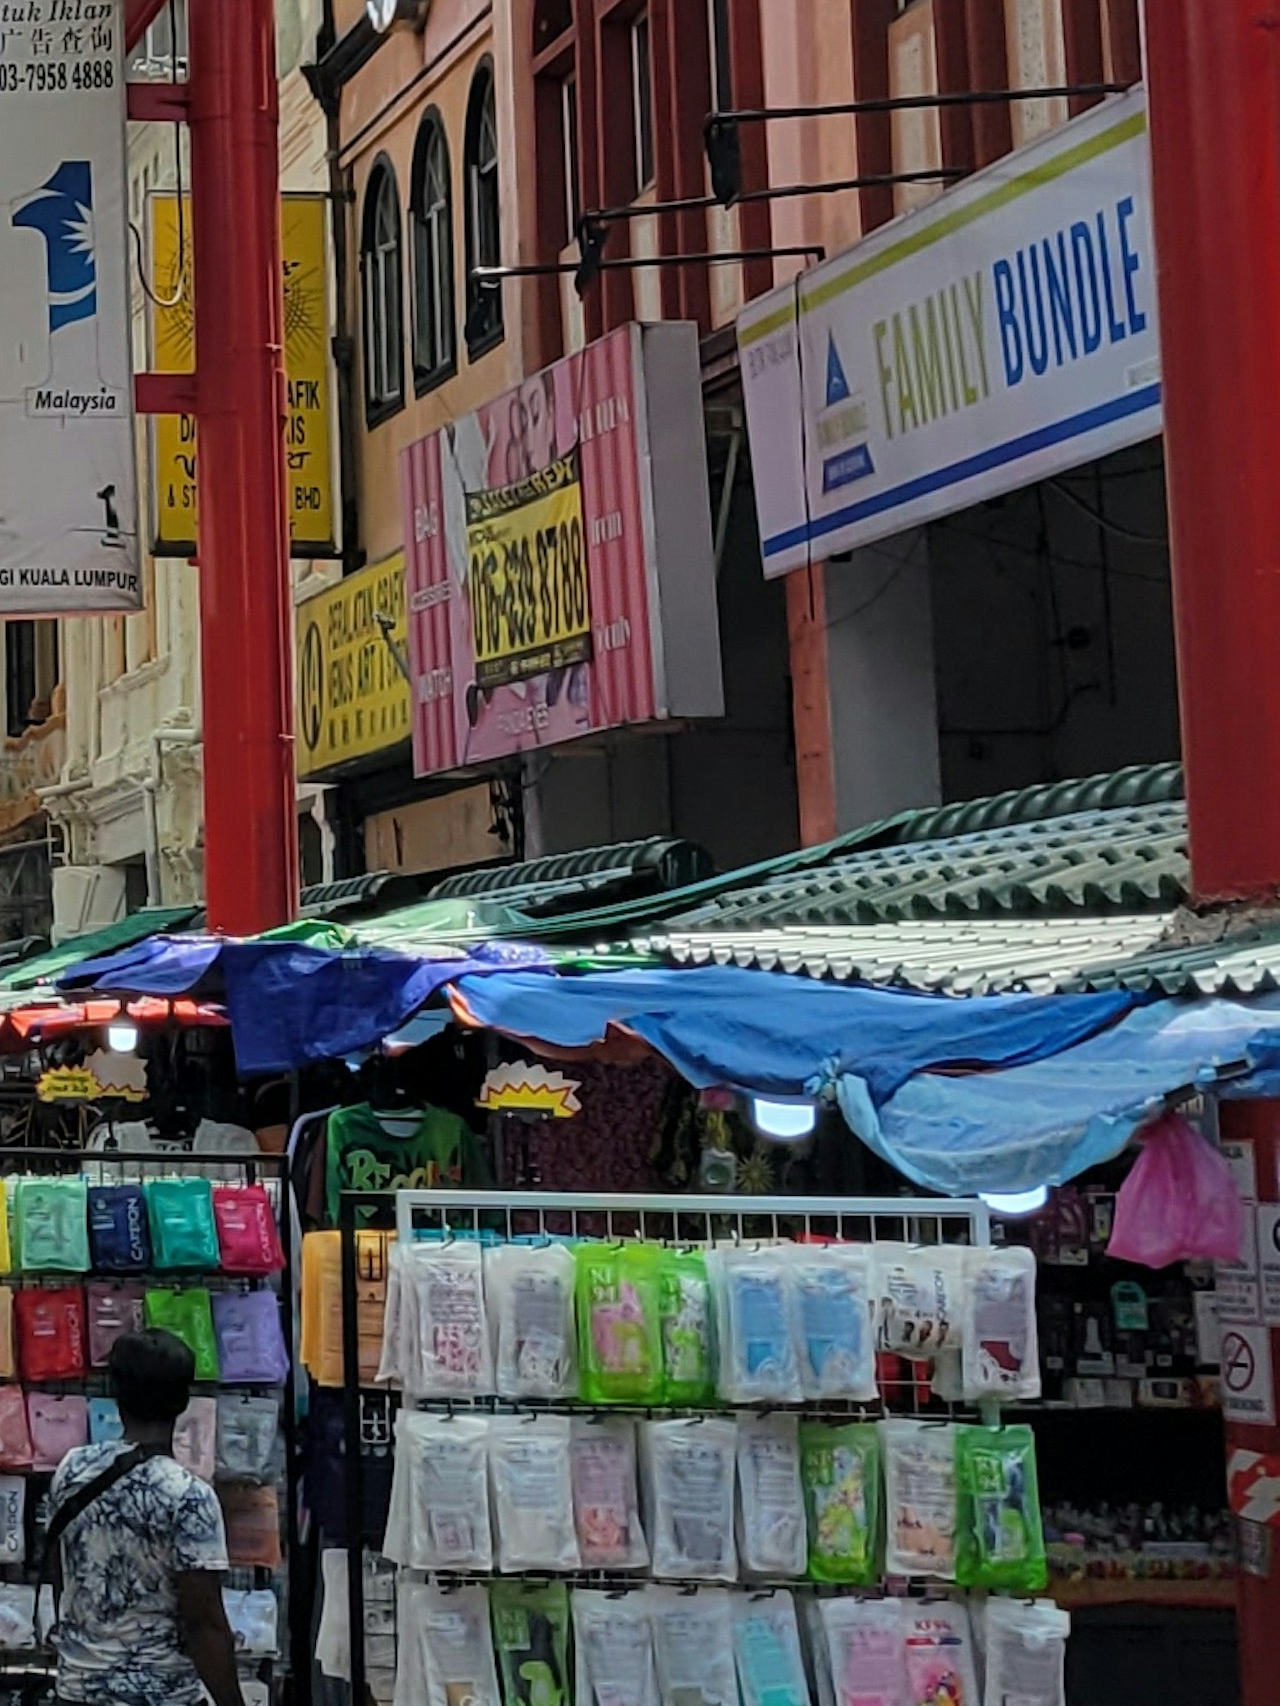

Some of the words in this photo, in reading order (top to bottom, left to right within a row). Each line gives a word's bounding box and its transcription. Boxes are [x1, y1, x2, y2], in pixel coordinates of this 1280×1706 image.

[72, 60, 115, 90] 4888
[871, 269, 991, 441] FAMILY
[992, 195, 1148, 389] BUNDLE
[35, 387, 116, 414] Malaysia
[19, 569, 70, 587] KUALA
[74, 570, 139, 592] LUMPUR
